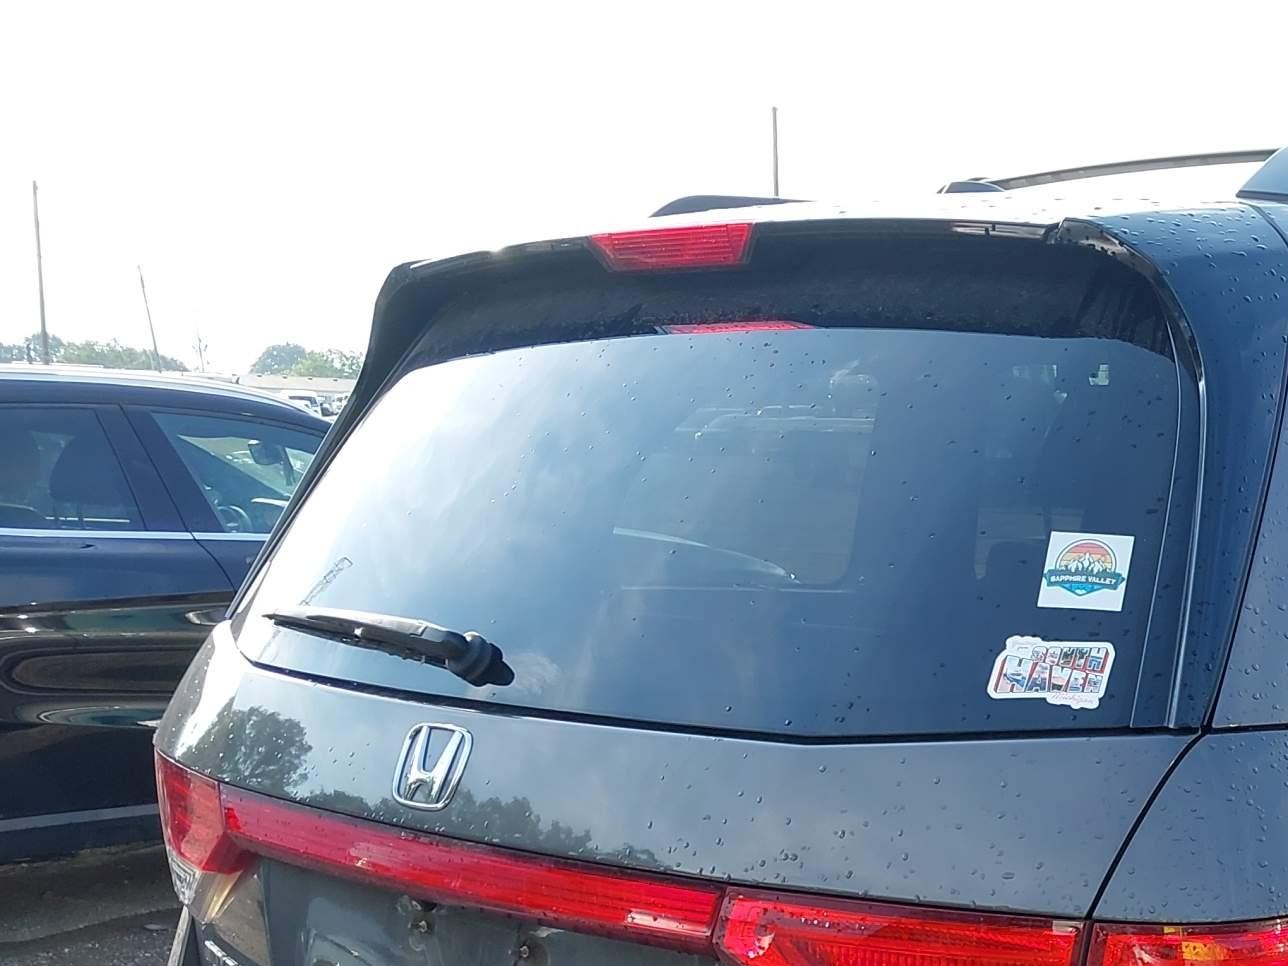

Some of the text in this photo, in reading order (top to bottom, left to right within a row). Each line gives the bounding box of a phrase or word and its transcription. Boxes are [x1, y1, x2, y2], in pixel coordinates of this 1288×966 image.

[1050, 575, 1118, 585] SAPPHIRE VALLEY
[1032, 645, 1107, 672] SOUTH
[997, 654, 1104, 693] HAVEN
